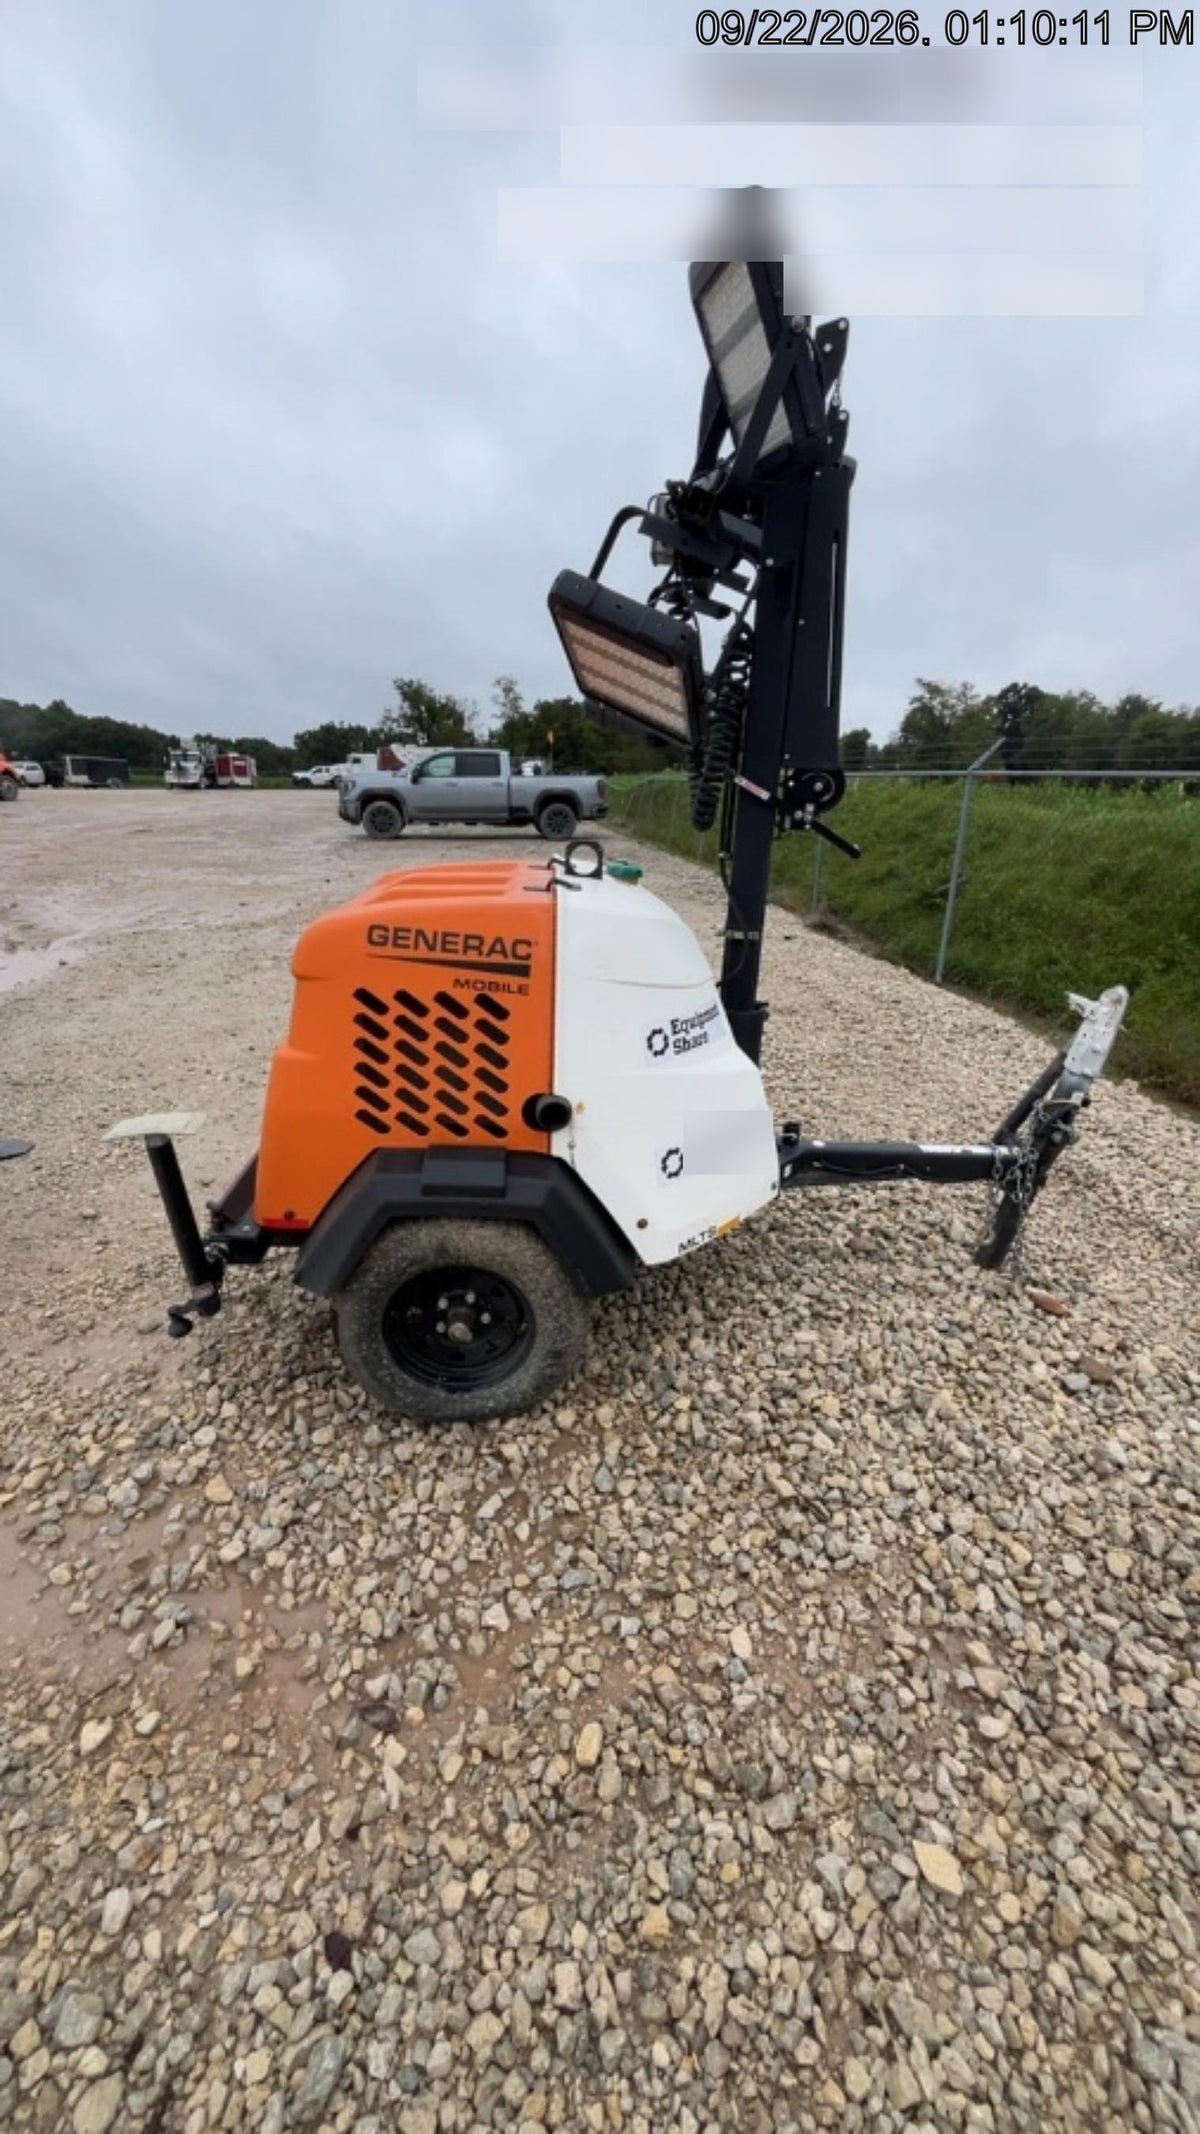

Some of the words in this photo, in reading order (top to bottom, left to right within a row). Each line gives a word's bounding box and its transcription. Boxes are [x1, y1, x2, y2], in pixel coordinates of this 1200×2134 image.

[367, 923, 532, 961] GENERAC
[453, 978, 530, 996] MOBILE
[673, 1031, 709, 1055] Share
